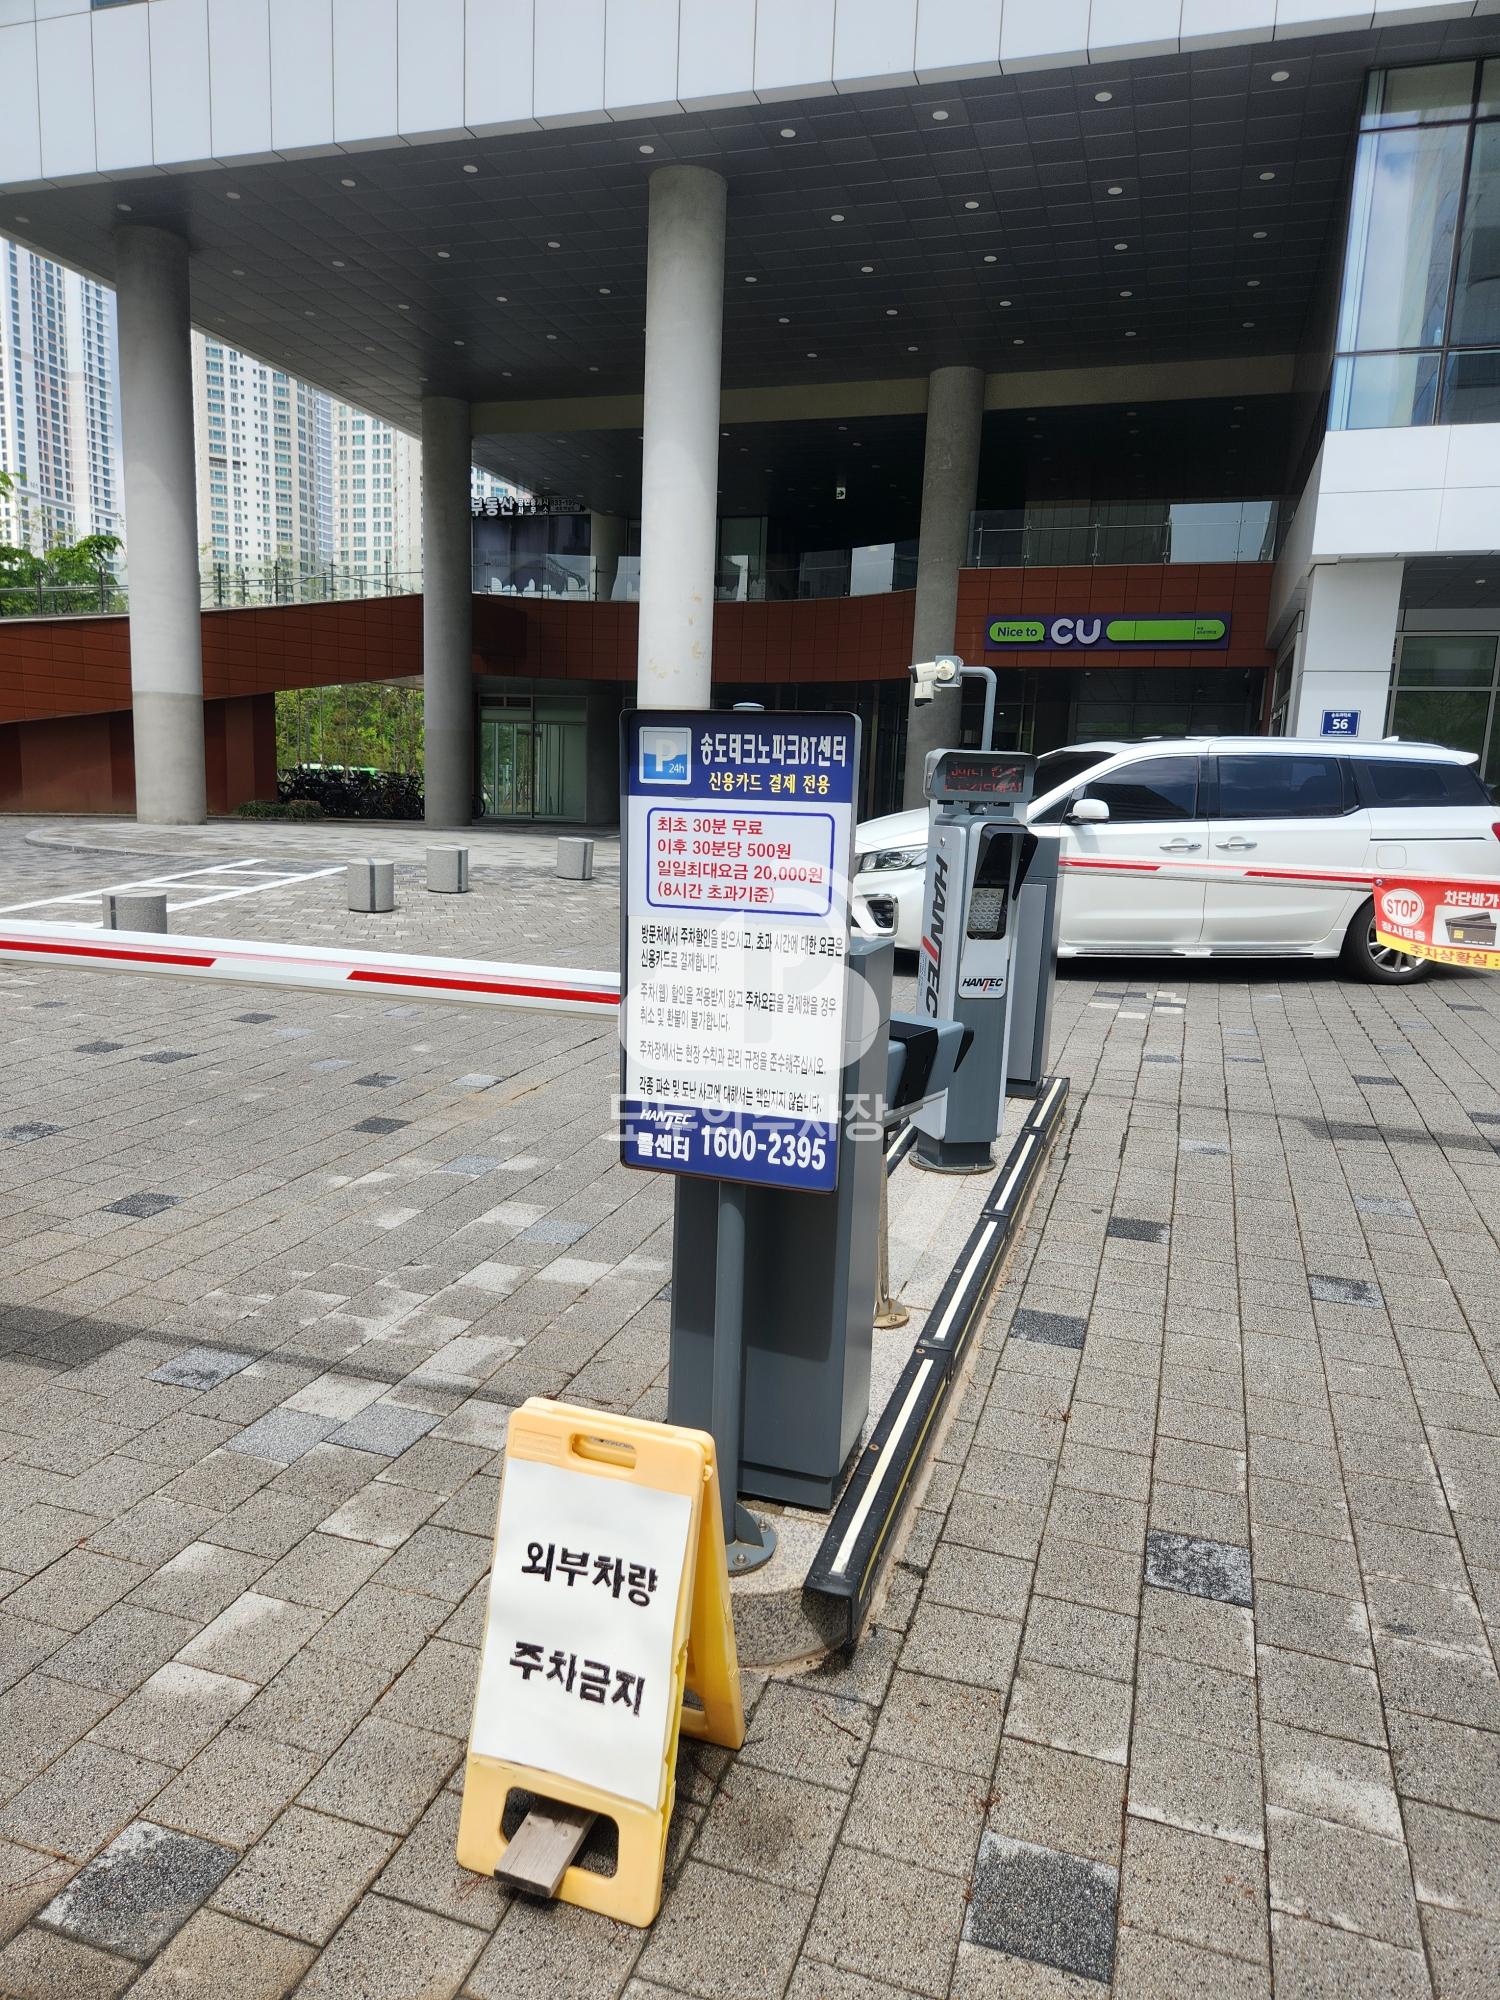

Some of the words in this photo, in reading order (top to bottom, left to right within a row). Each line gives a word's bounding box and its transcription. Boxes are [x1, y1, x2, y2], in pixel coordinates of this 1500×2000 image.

[471, 496, 514, 516] 부동산
[998, 627, 1024, 637] Nice
[1026, 628, 1038, 637] to
[1050, 618, 1102, 645] CU
[1332, 718, 1348, 730] 56
[700, 733, 847, 767] 송도테크노파크BT센터
[668, 763, 685, 774] 24h
[709, 772, 762, 792] 신용카드
[769, 773, 796, 794] 결제
[803, 775, 830, 795] 전용
[657, 817, 688, 833] 최초
[693, 818, 727, 835] 30분
[732, 820, 763, 836] 무료
[657, 839, 687, 855] 이후
[693, 841, 742, 858] 30분당
[747, 843, 791, 860] 500원
[657, 860, 748, 880] 일일최대요금
[754, 865, 823, 884] 20,000원
[658, 882, 702, 899] (8시간
[707, 884, 775, 903] 초과기준)
[1443, 889, 1500, 908] 차단바가
[1386, 898, 1418, 918] STOP
[641, 924, 678, 946] 방문처에서
[680, 927, 718, 949] 주차할인을
[721, 929, 754, 952] 받으시고,
[756, 932, 772, 953] 초과
[775, 933, 799, 955] 시간에
[801, 934, 817, 955] 대한
[819, 936, 843, 957] 요금은
[641, 948, 678, 969] 신용카드로
[680, 951, 720, 973] 결제합니다.
[1409, 943, 1488, 967] 주차상황실
[961, 977, 1004, 993] HANTEC
[672, 984, 694, 1005] 할인을
[696, 986, 726, 1008] 적용받지
[728, 989, 743, 1009] 않고
[745, 991, 784, 1013] 주차요금을
[787, 993, 818, 1016] 결제했을
[821, 996, 836, 1017] 경우
[640, 1005, 655, 1025] 취소
[657, 1007, 665, 1027] 및
[667, 1008, 689, 1028] 환불이
[691, 1010, 731, 1032] 불가합니다.
[640, 1040, 683, 1062] 주차장에서는
[685, 1043, 700, 1064] 현장
[702, 1046, 725, 1067] 수칙과
[727, 1048, 743, 1069] 관리
[744, 1050, 767, 1071] 규정을
[639, 1076, 654, 1096] 각종
[656, 1077, 670, 1097] 파손
[672, 1079, 680, 1098] 및
[682, 1081, 697, 1100] 도난
[699, 1082, 721, 1103] 사고에
[723, 1085, 753, 1106] 대해서는
[756, 1087, 786, 1110] 책임지지
[788, 1091, 822, 1114] 않습니다.
[639, 1108, 692, 1131] HANTEC
[637, 1131, 690, 1162] 콜센터
[700, 1124, 827, 1171] 1600-2395
[520, 1541, 659, 1607] 외부차량
[508, 1640, 646, 1718] 주차금지
